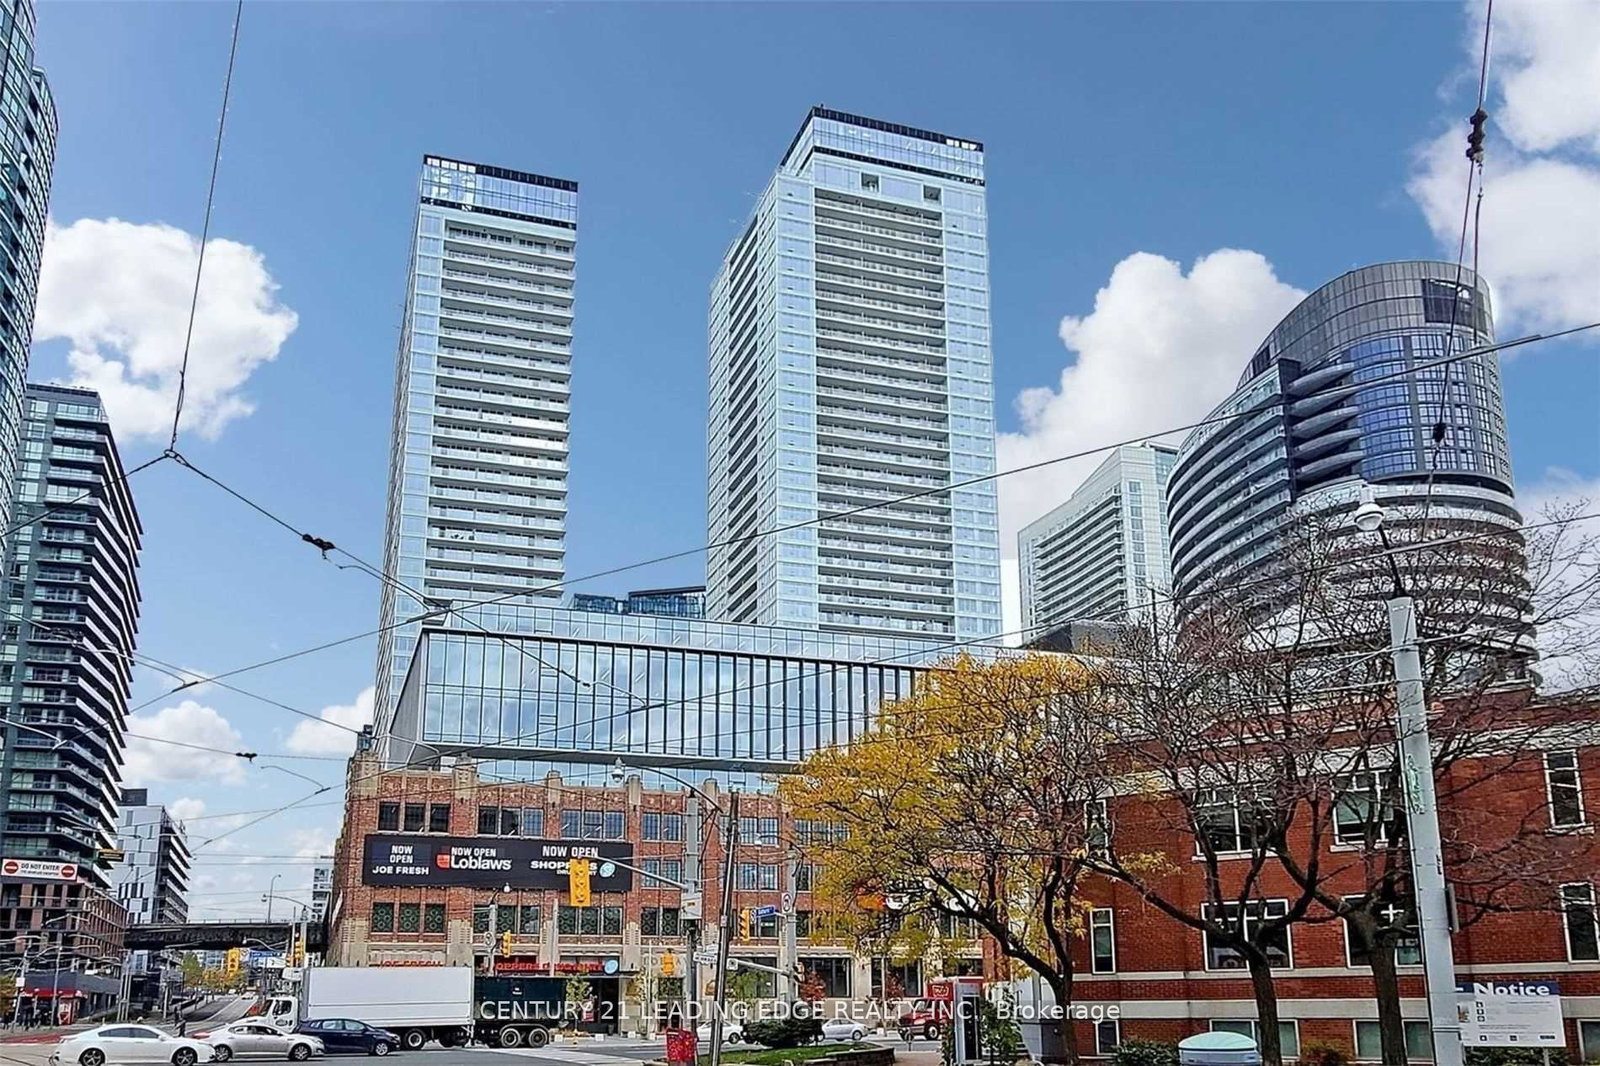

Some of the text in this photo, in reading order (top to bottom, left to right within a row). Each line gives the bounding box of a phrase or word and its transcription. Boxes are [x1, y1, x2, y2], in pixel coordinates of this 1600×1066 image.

[391, 845, 413, 855] NOW
[451, 847, 497, 857] NOW OPEN
[542, 845, 599, 858] NOW OPEN
[389, 854, 413, 864] OPEN
[451, 856, 513, 871] Loblaws
[372, 865, 430, 875] JOE FRESH
[1473, 982, 1550, 996] Notice
